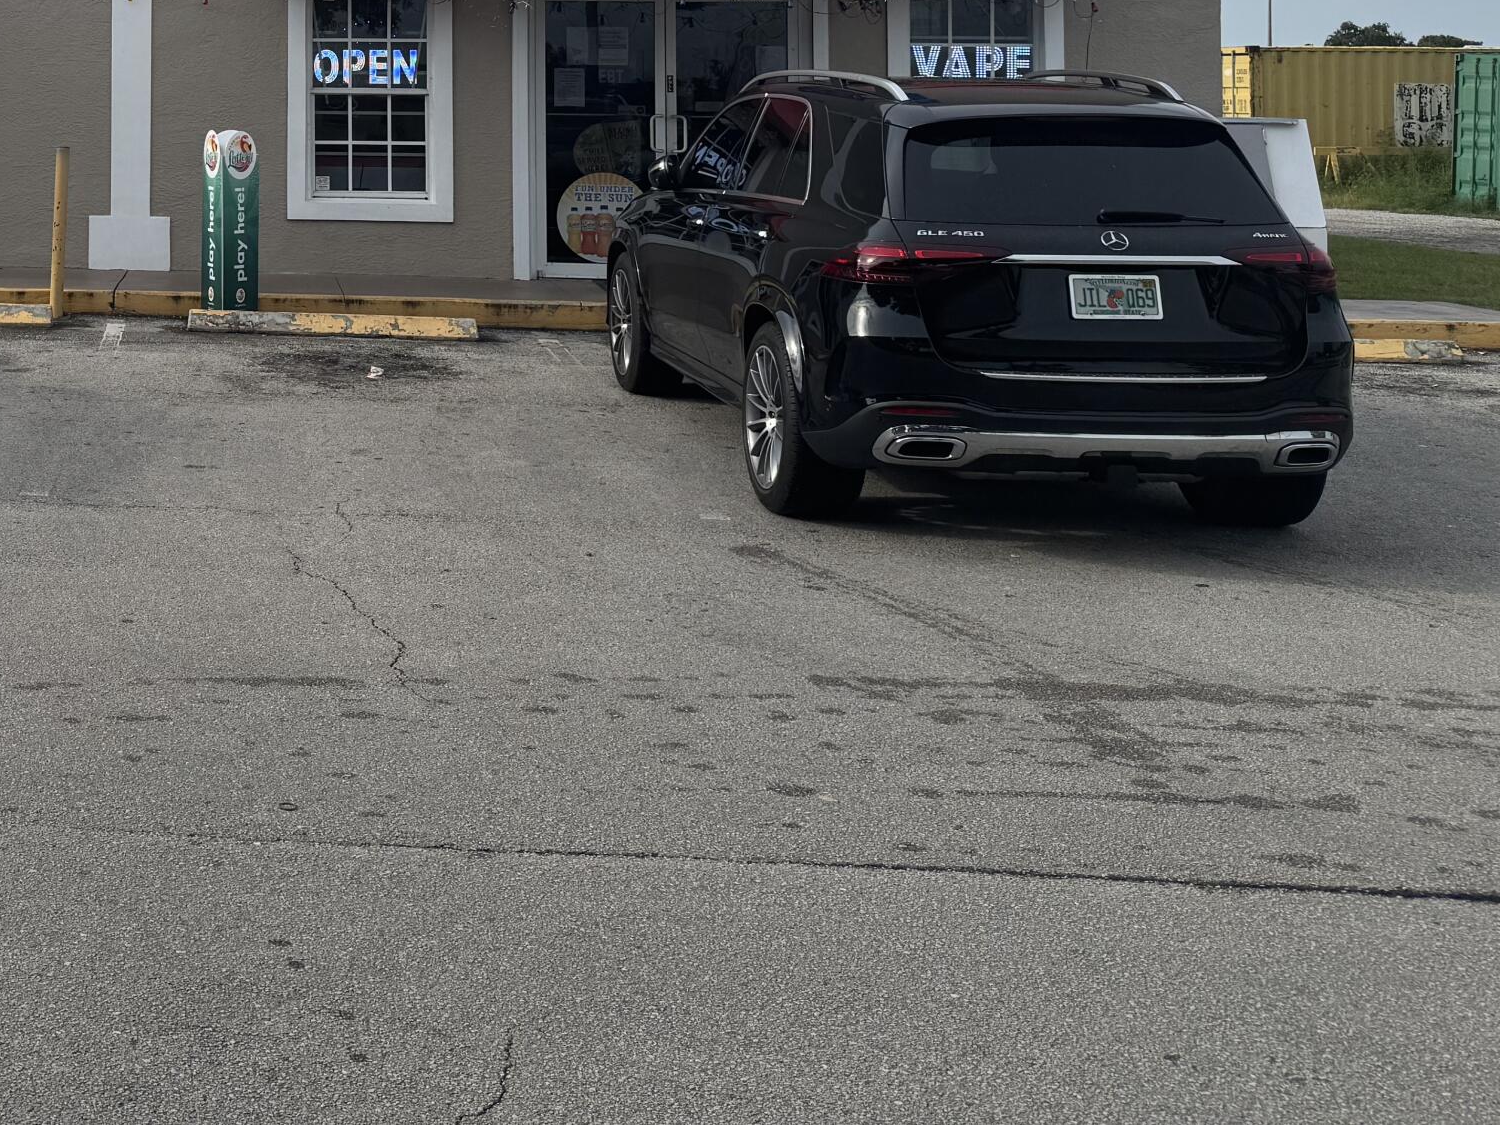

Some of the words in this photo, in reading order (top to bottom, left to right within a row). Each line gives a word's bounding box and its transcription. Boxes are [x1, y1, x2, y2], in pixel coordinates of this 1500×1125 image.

[314, 49, 417, 84] OPEN
[912, 45, 1030, 78] VAPE
[575, 192, 602, 202] THE
[608, 193, 634, 203] SUN
[600, 185, 634, 193] UNDER
[234, 187, 245, 234] here!
[208, 237, 216, 281] play
[234, 239, 248, 282] play
[1077, 288, 1106, 308] JIL
